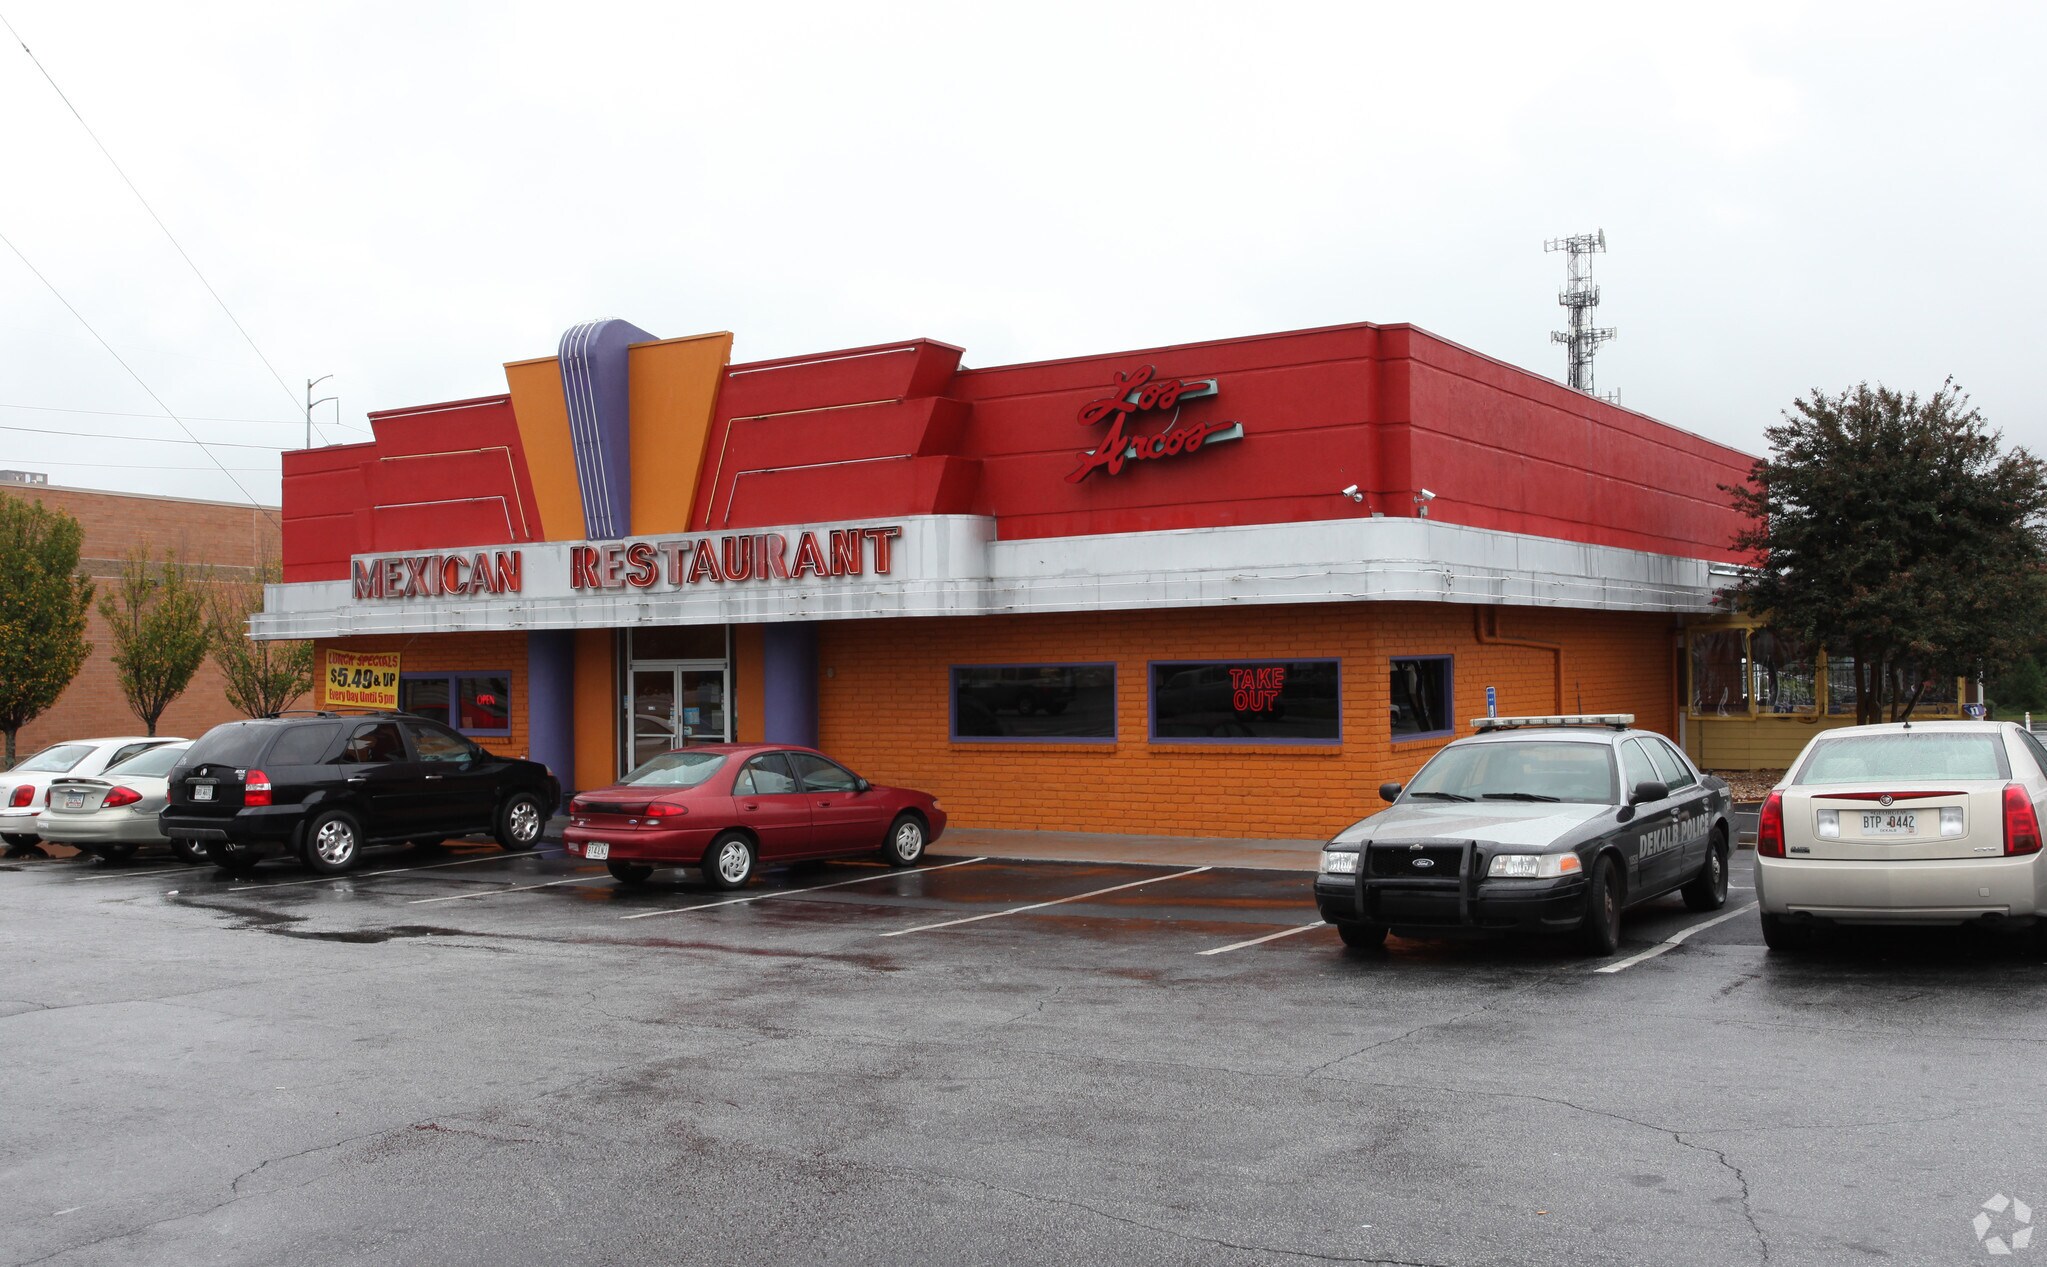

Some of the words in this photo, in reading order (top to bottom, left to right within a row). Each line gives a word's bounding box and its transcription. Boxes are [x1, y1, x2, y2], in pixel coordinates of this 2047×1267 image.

[1077, 364, 1211, 426] Los
[1064, 412, 1237, 484] Arcos
[352, 551, 522, 599] MEXICAN
[570, 526, 902, 589] RESTAURANT
[328, 652, 356, 666] LUNCH
[357, 654, 398, 668] SPECIALS
[330, 672, 373, 689] $5.49
[373, 674, 381, 687] &
[382, 672, 396, 687] UP
[1229, 667, 1285, 690] TAKE
[329, 688, 346, 702] Every
[346, 689, 359, 703] Day
[360, 691, 377, 704] Until
[476, 694, 495, 705] OPEN
[1233, 689, 1278, 712] OUT
[1863, 815, 1882, 829] BTP
[1889, 815, 1915, 829] 0442
[1639, 823, 1680, 860] DEKALB
[1681, 811, 1710, 842] POLICE
